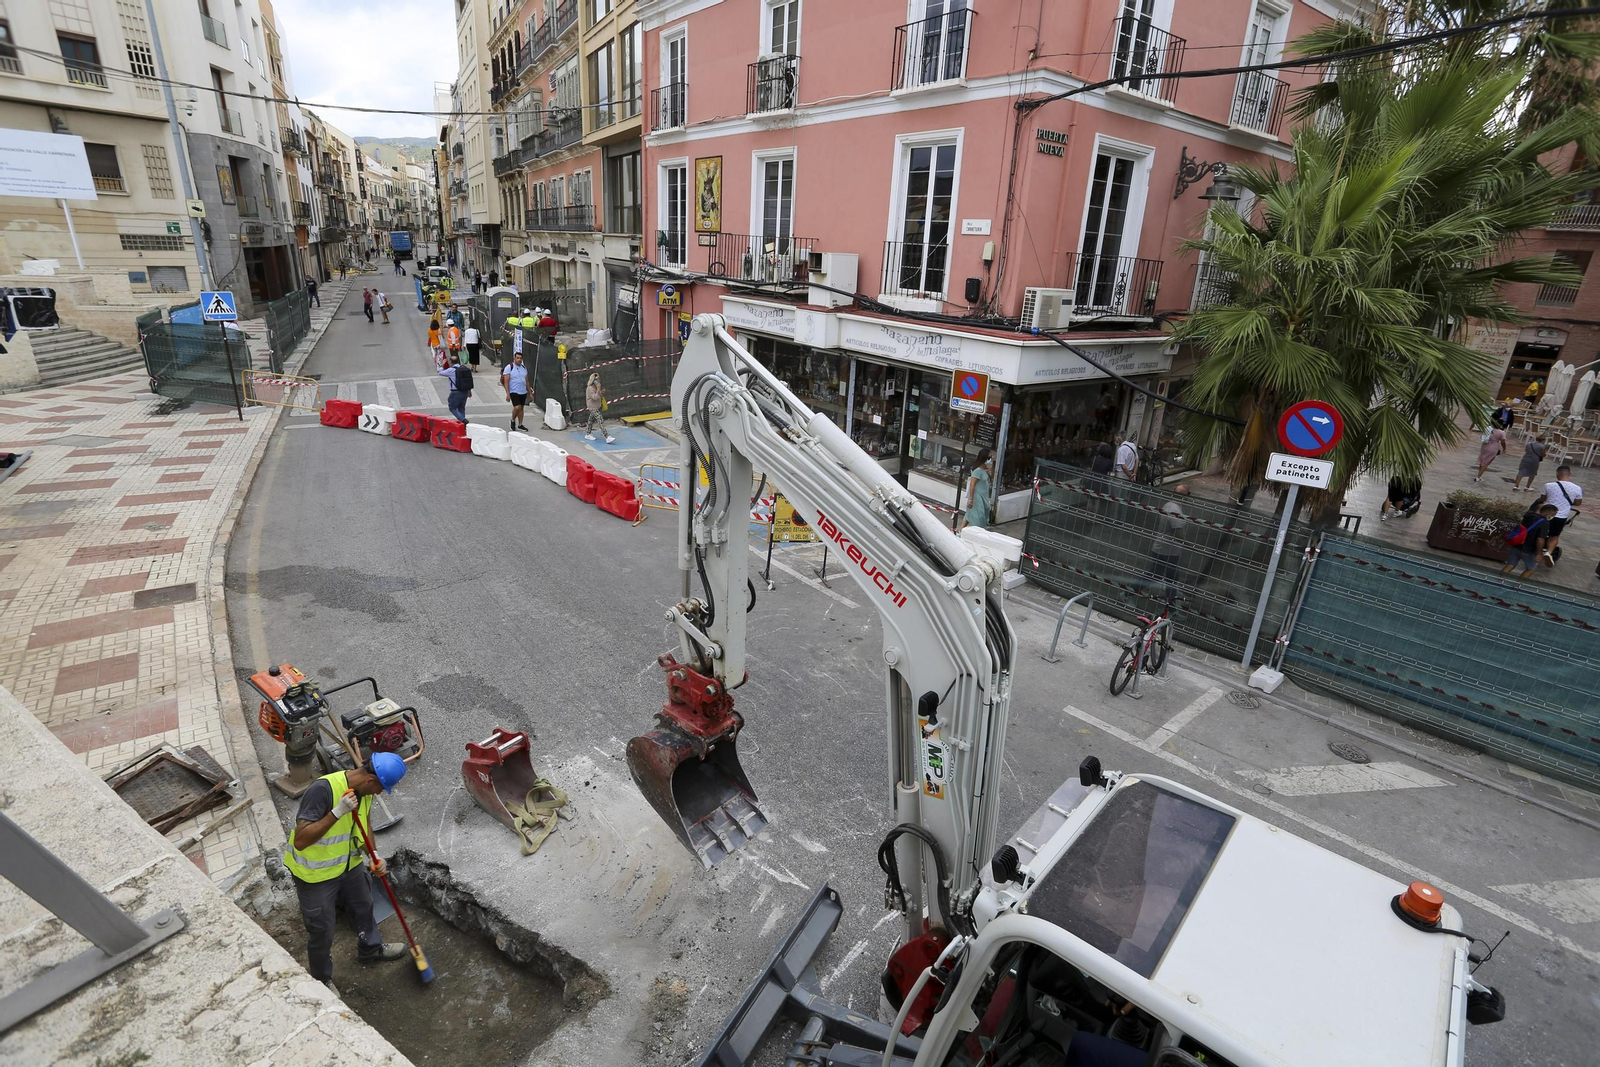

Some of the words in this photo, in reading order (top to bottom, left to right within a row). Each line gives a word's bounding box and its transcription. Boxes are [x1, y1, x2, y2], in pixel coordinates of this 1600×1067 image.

[1037, 128, 1069, 144] PUERTA
[1038, 143, 1065, 157] NUEVA
[845, 337, 870, 348] ARTICULOS
[870, 343, 897, 354] RELIGIOSOS
[935, 355, 963, 367] COFRADES
[1034, 368, 1061, 377] ARTICULOS
[1060, 366, 1087, 375] RELIGIOSOS
[1281, 460, 1320, 473] Excepto
[1275, 468, 1320, 481] patinetes
